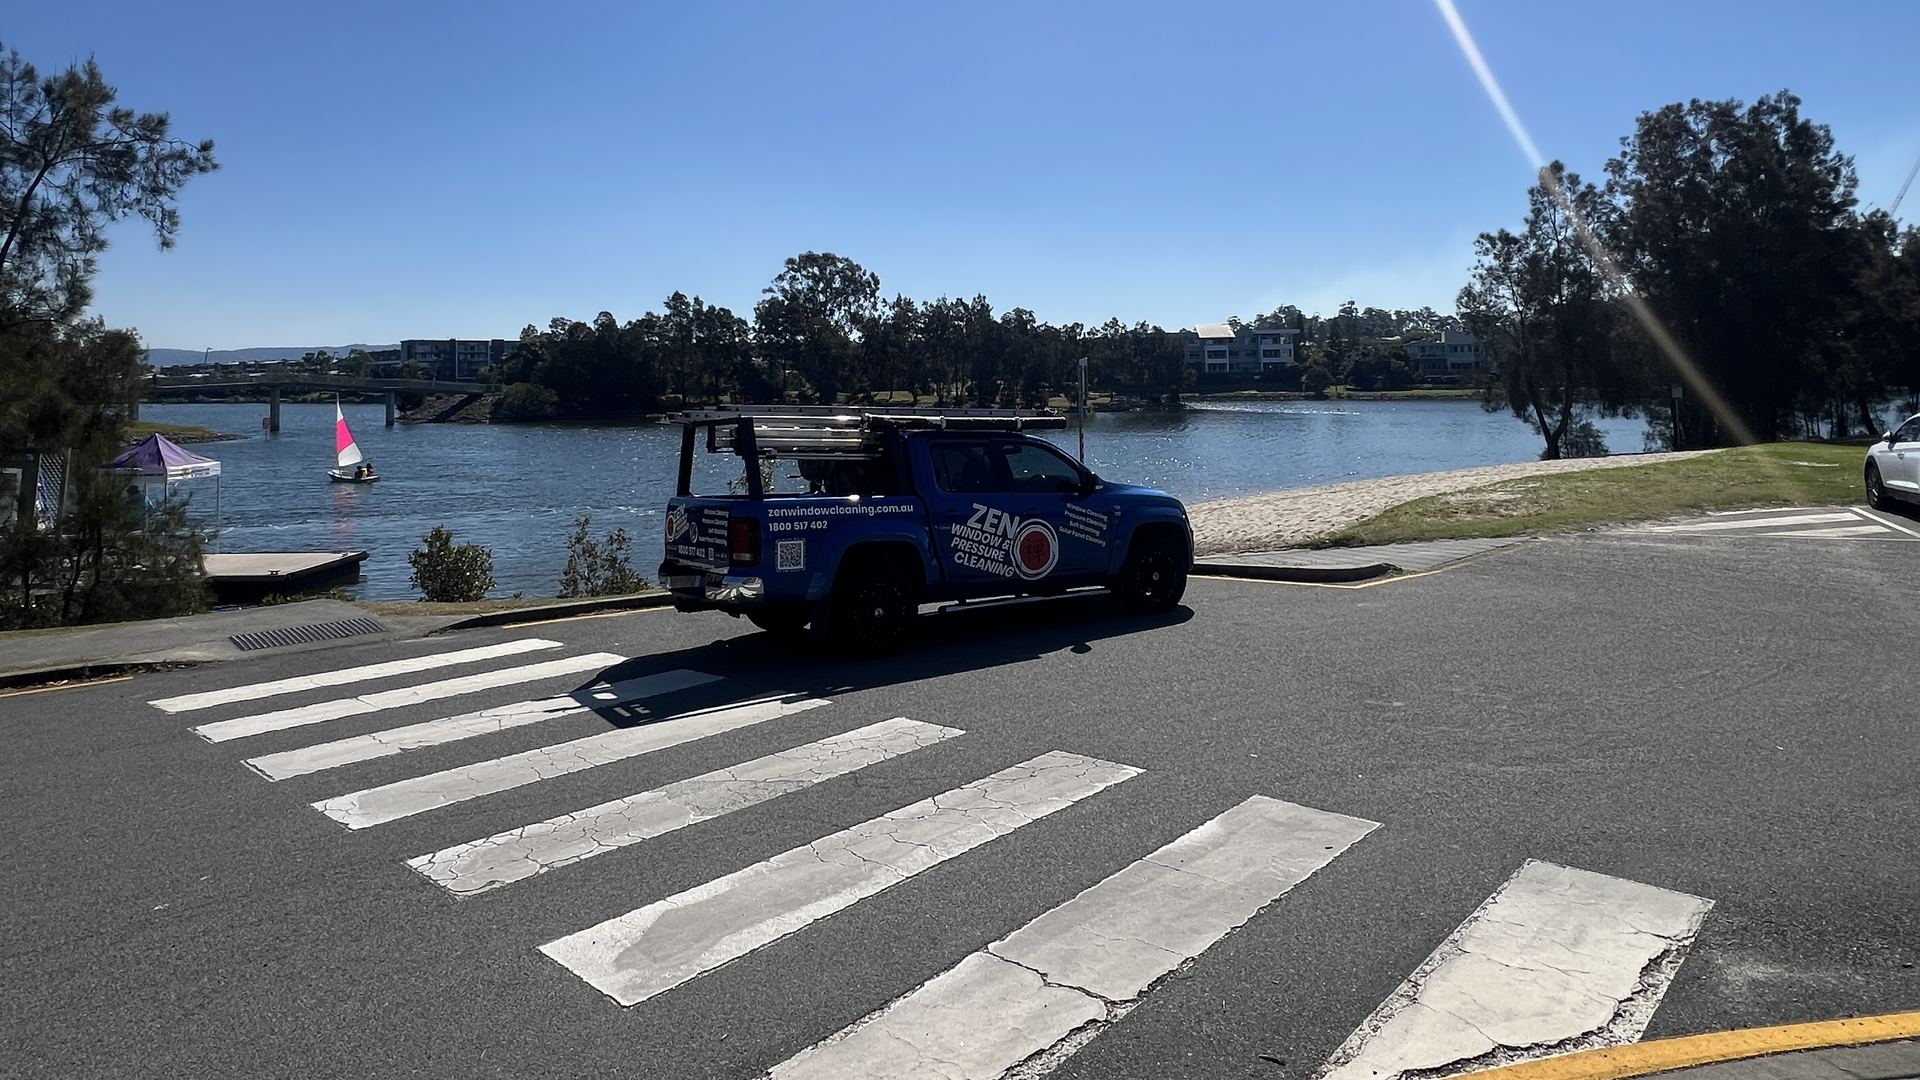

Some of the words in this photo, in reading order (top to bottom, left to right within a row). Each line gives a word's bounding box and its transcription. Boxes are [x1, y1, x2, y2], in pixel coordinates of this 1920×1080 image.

[767, 504, 914, 517] zenwindowcleaning.com.au
[966, 502, 1021, 539] ZEN
[768, 522, 792, 532] 1800
[793, 521, 808, 531] 517
[809, 520, 828, 530] 402
[950, 522, 1003, 547] WINDOW
[1001, 539, 1011, 551] &
[950, 536, 1006, 561] PRESSURE
[953, 551, 1015, 578] CLEANING
